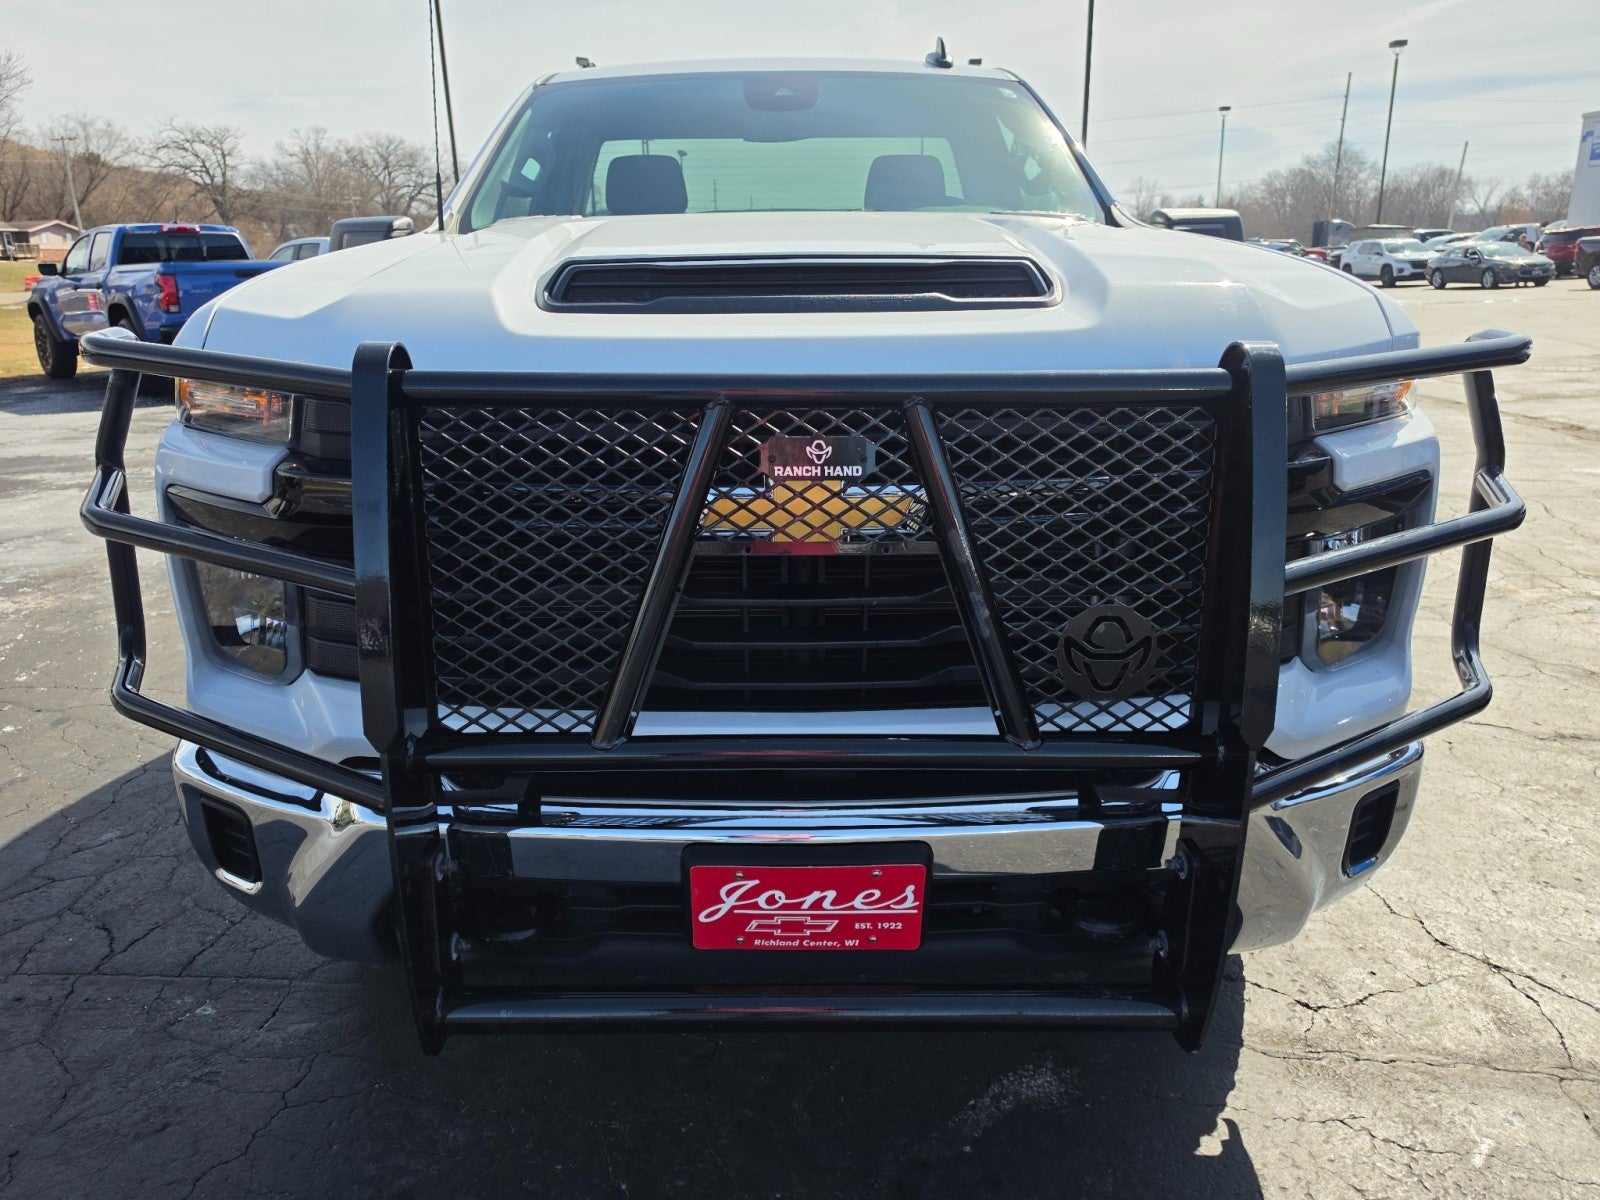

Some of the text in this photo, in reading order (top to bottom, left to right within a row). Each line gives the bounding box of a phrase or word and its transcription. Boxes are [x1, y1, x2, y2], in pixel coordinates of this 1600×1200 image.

[774, 465, 863, 477] RANCH HAND
[698, 879, 920, 923] Jones
[854, 922, 903, 930] EST. 1922
[753, 938, 860, 948] Richland Center, WI
